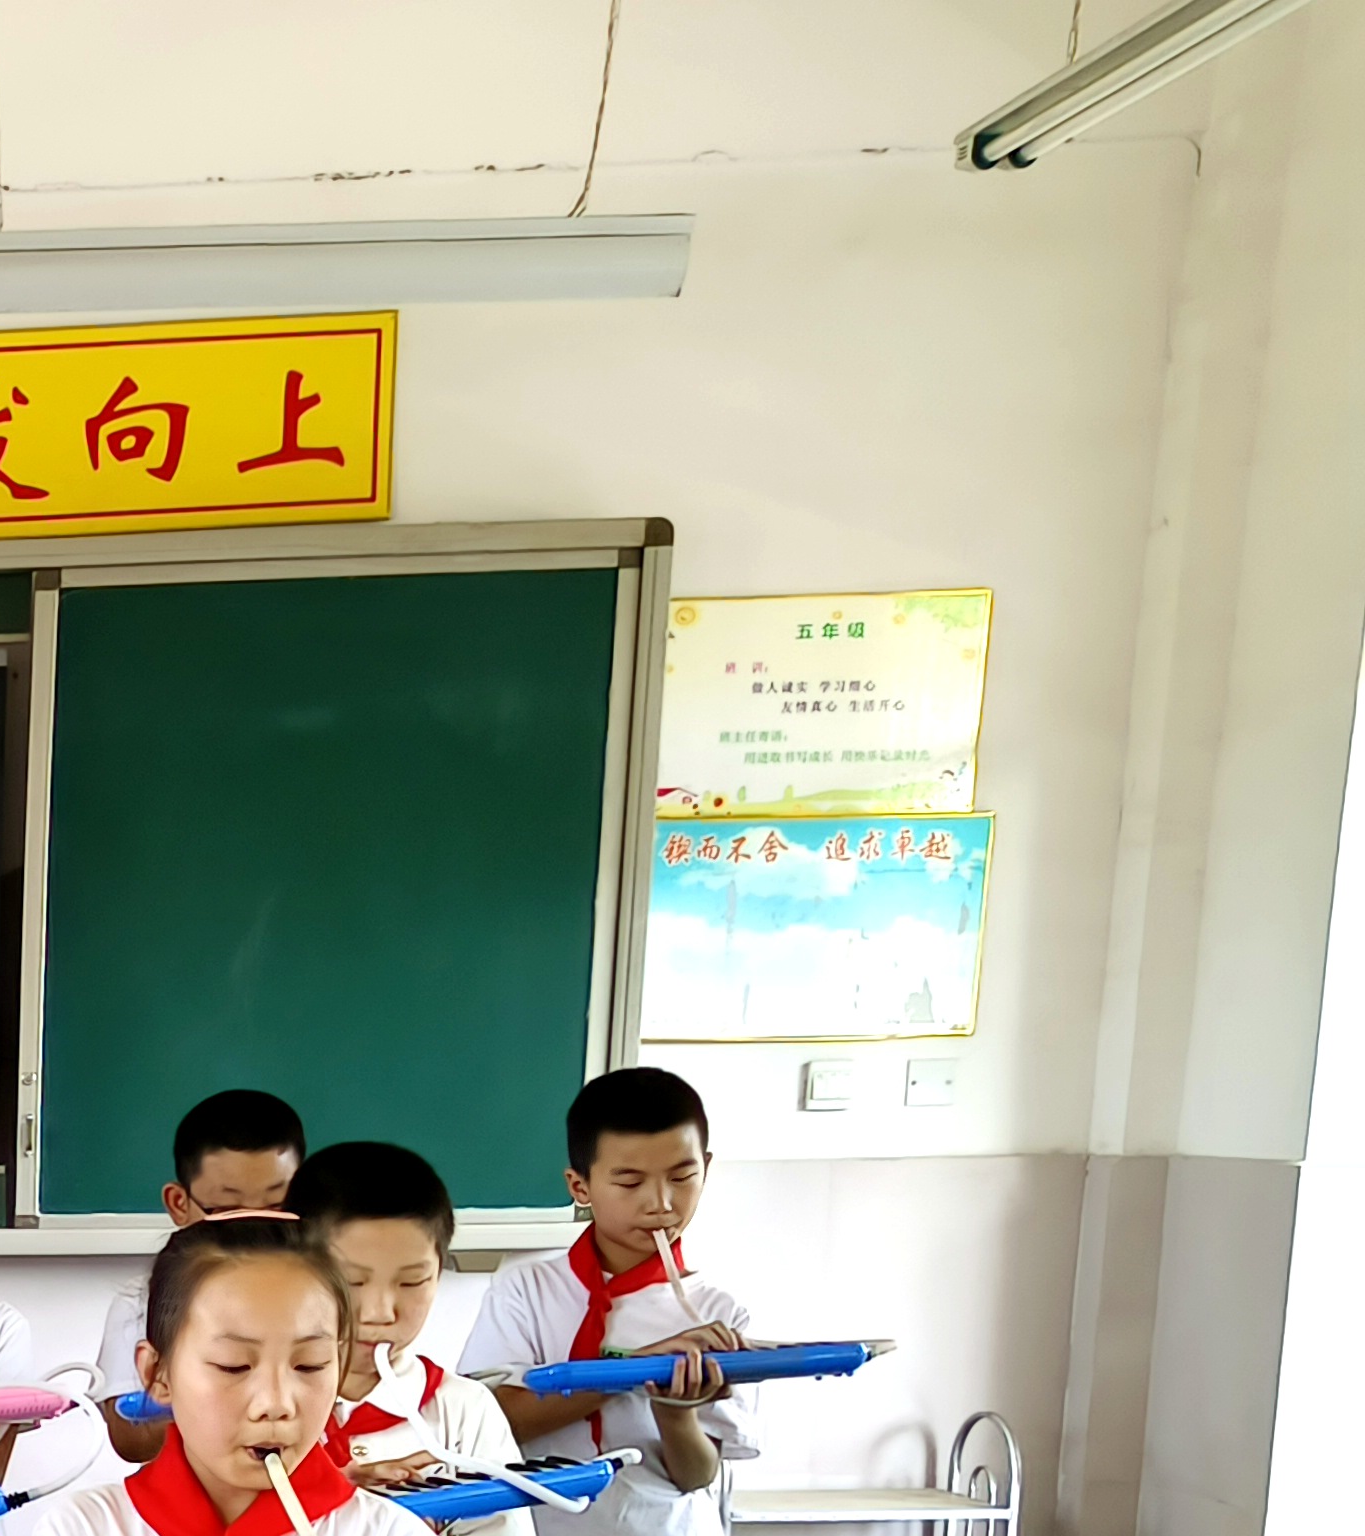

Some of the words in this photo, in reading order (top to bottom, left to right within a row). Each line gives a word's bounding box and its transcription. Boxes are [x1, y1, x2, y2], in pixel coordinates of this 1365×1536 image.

[796, 622, 865, 640] 五年级
[664, 829, 788, 863] 锲而不舍
[826, 829, 953, 862] 追求卓越
